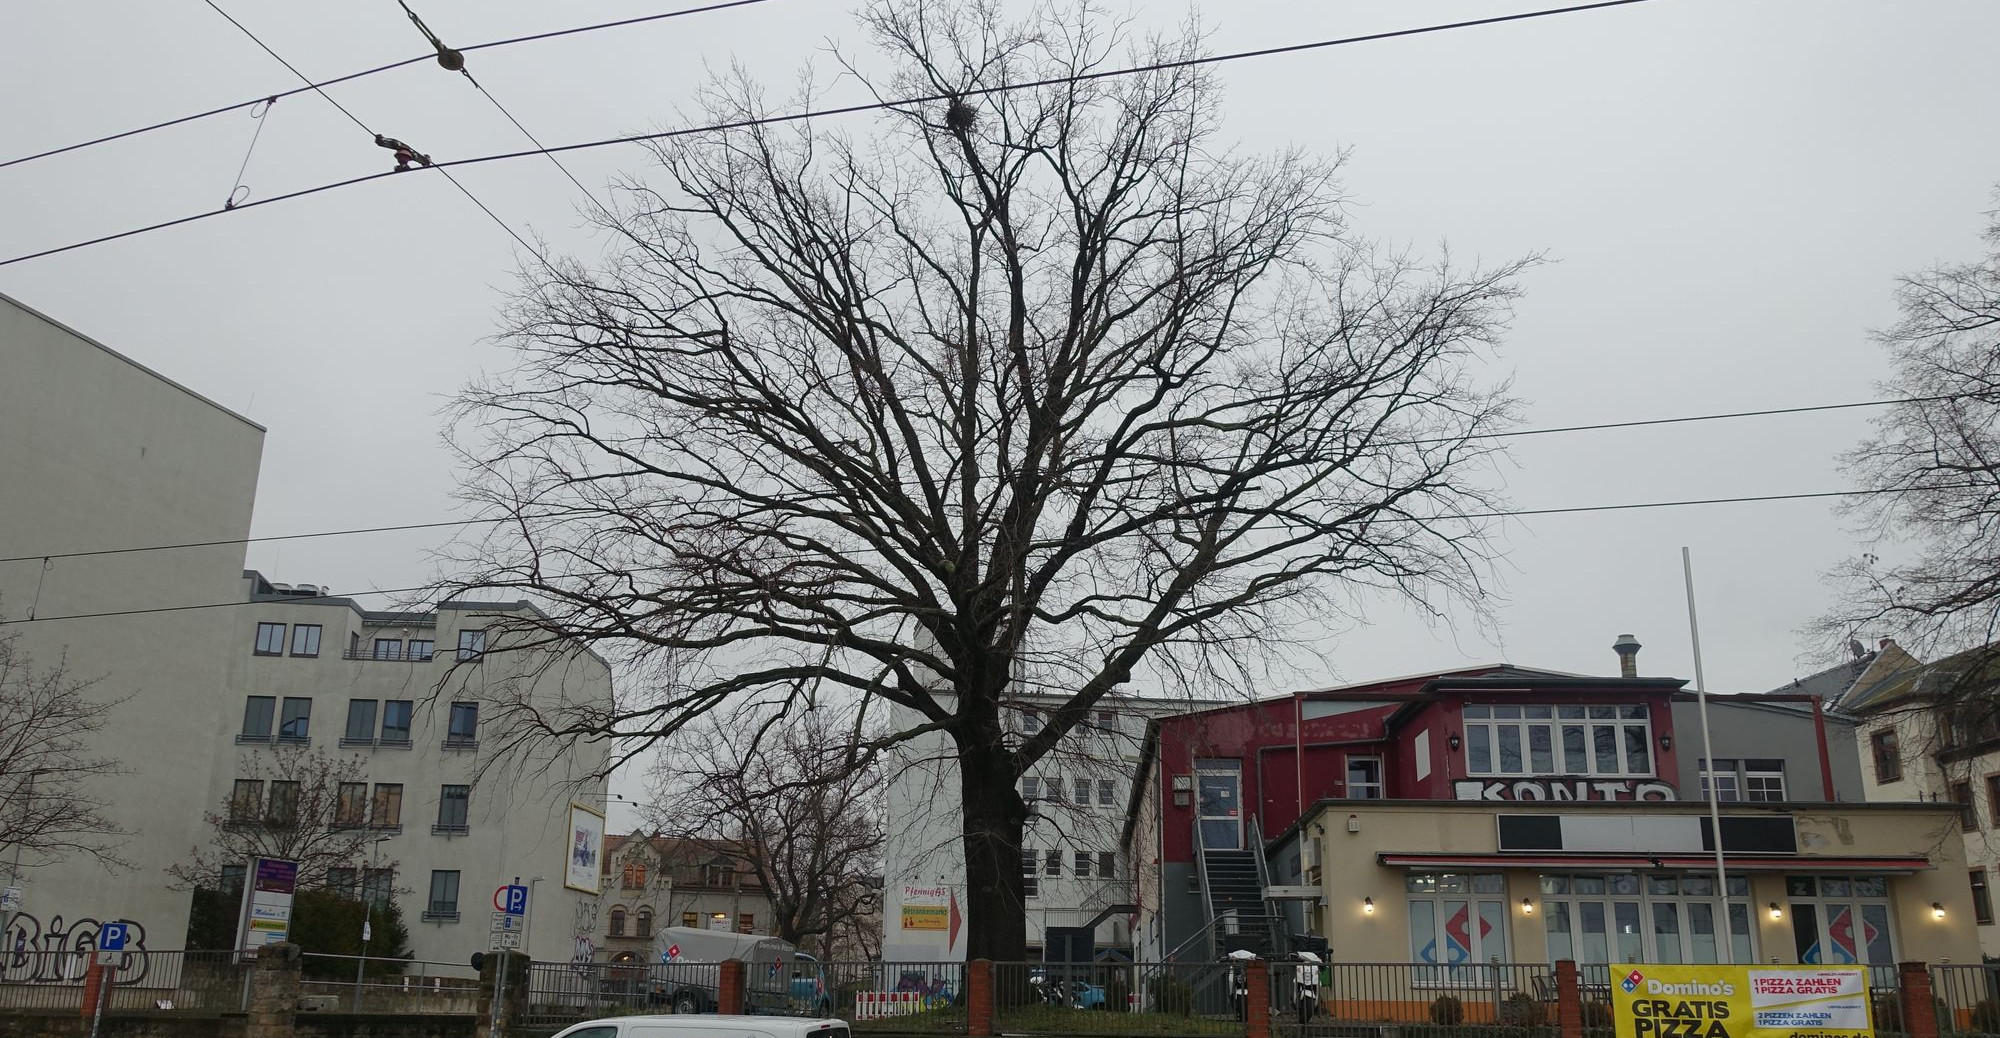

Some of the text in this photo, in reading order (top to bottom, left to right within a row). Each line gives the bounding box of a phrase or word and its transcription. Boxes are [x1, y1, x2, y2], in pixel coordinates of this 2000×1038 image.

[510, 889, 523, 911] P
[105, 927, 121, 947] P
[1648, 980, 1734, 996] Domino's
[1632, 1000, 1730, 1019] GRATIS
[1634, 1018, 1731, 1038] PIZZA
